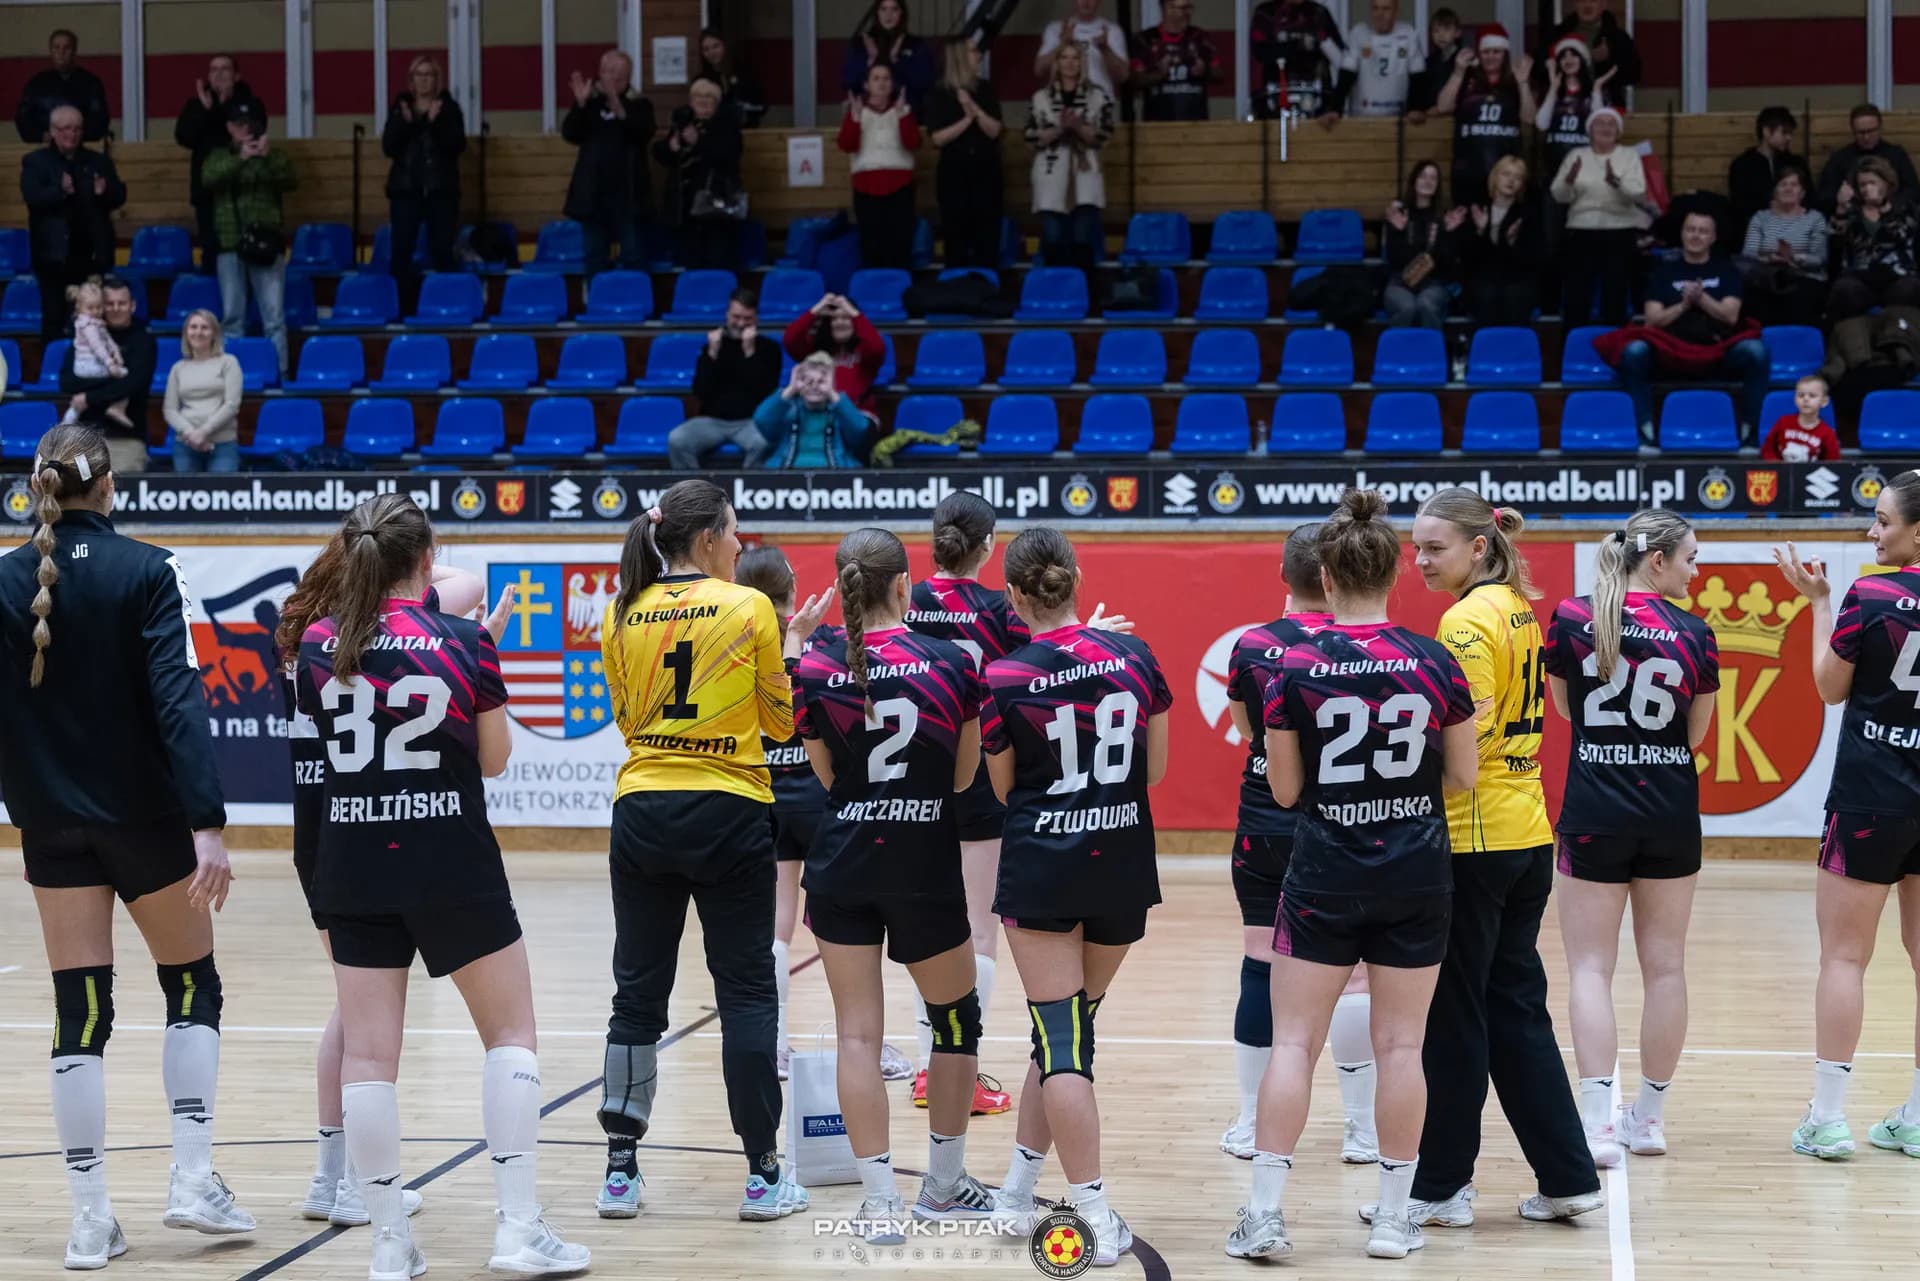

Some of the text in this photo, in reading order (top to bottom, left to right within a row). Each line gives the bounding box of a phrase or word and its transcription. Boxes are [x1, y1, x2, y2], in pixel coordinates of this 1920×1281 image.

[1478, 104, 1502, 121] 10
[1559, 115, 1579, 131] 10
[72, 544, 89, 559] JG
[644, 605, 719, 624] LEWIATAN
[917, 610, 978, 624] LEWIATAN
[367, 635, 443, 651] WIATAN
[1620, 626, 1678, 642] WIATAN
[662, 640, 698, 719] 1
[1050, 657, 1126, 687] LEWIATAN
[1330, 658, 1418, 676] LEWIATAN
[1582, 652, 1684, 731] 26
[226, 717, 259, 737] na
[265, 713, 287, 737] ta
[320, 674, 452, 773] 32
[1316, 693, 1432, 784] 23
[1864, 719, 1920, 749] OLEJ
[865, 697, 919, 783] 2
[1045, 690, 1139, 795] 18
[330, 789, 462, 823] BERLIŃSKA
[1034, 801, 1139, 833] PIWOWAR
